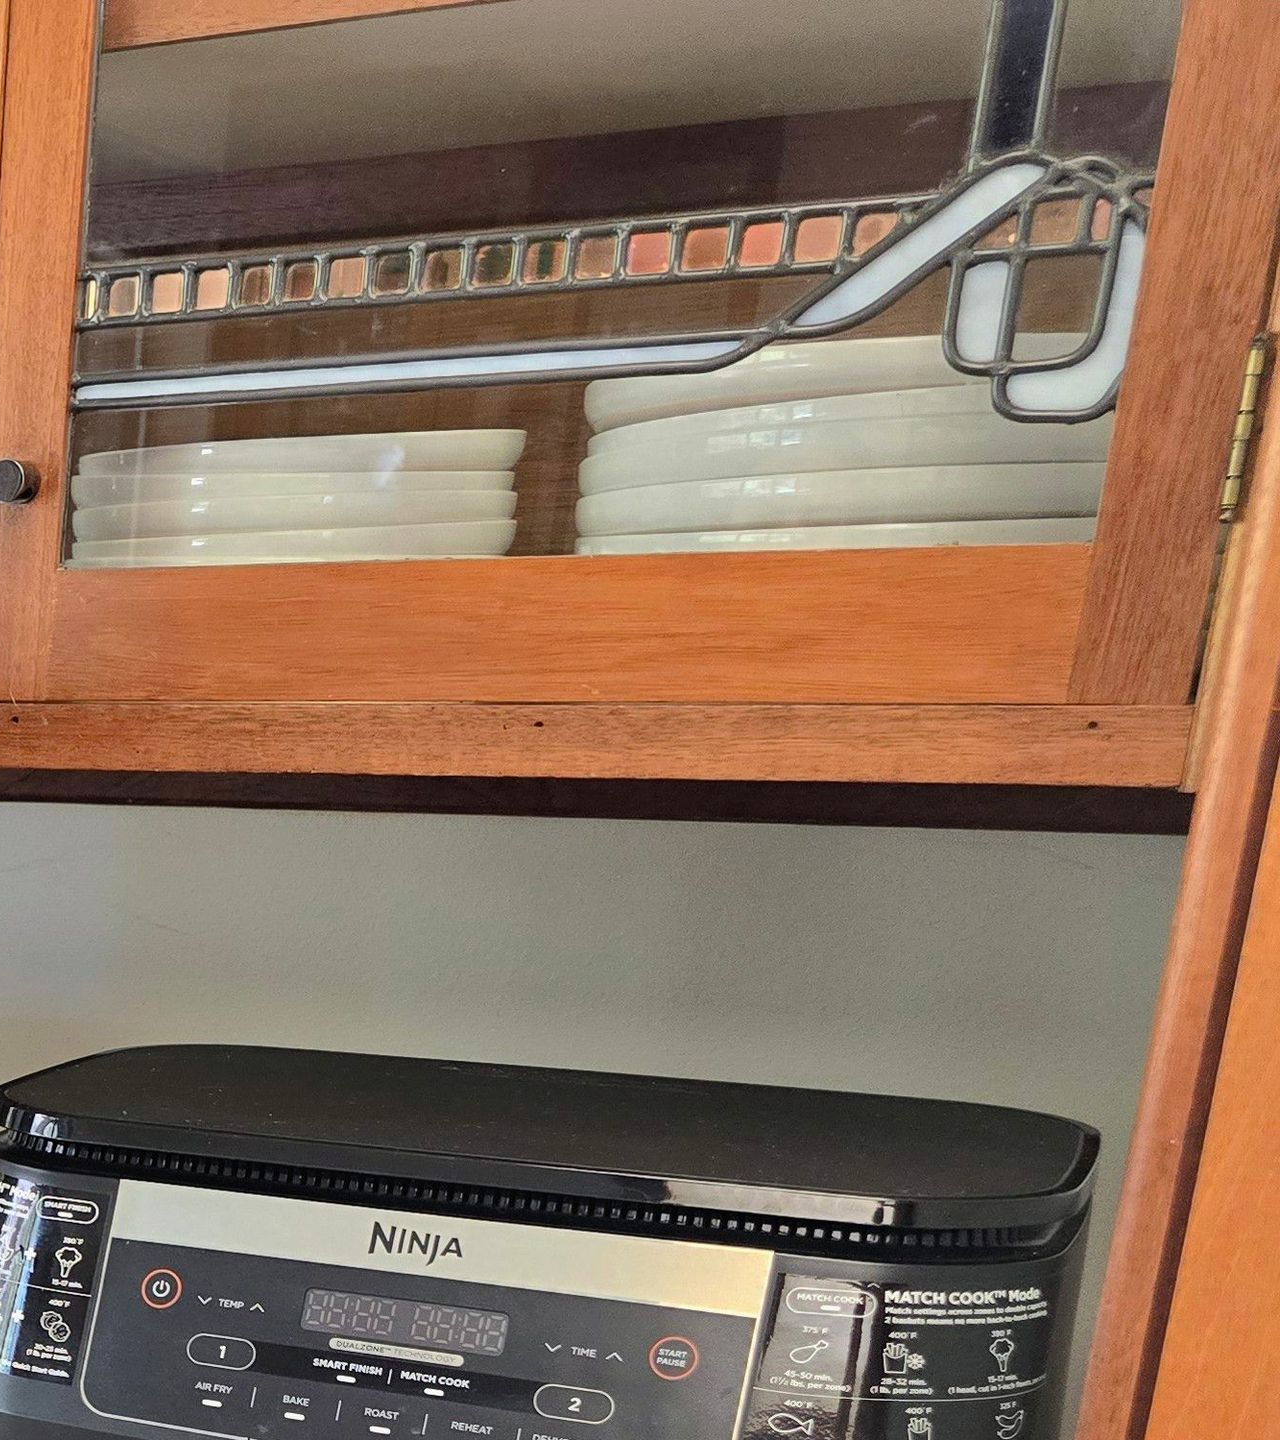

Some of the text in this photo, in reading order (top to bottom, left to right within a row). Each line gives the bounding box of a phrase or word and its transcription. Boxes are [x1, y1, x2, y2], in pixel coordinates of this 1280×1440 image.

[368, 1220, 463, 1267] NINJA
[796, 1292, 865, 1305] MATCH COOK
[884, 1289, 946, 1304] MATCH
[1008, 1286, 1040, 1302] Mode
[218, 1297, 245, 1309] TEMP
[884, 1306, 912, 1315] Match
[913, 1306, 947, 1316] settings
[219, 1345, 227, 1359] 1
[392, 1348, 457, 1364] TECHNOLOGY
[570, 1345, 597, 1359] TIME
[658, 1348, 688, 1360] START
[312, 1357, 384, 1377] SMART FINISH
[656, 1356, 688, 1368] PAUSE
[400, 1370, 471, 1389] MATCH COOK
[783, 1370, 833, 1382] 45-50 min.
[908, 1378, 928, 1386] min.
[195, 1381, 234, 1395] AIR FRY
[790, 1379, 852, 1392] lbs. per zone)
[892, 1387, 908, 1395] per
[282, 1394, 310, 1407] BAKE
[568, 1397, 581, 1412] 2
[363, 1407, 400, 1421] ROAST
[450, 1420, 493, 1436] REHEAT
